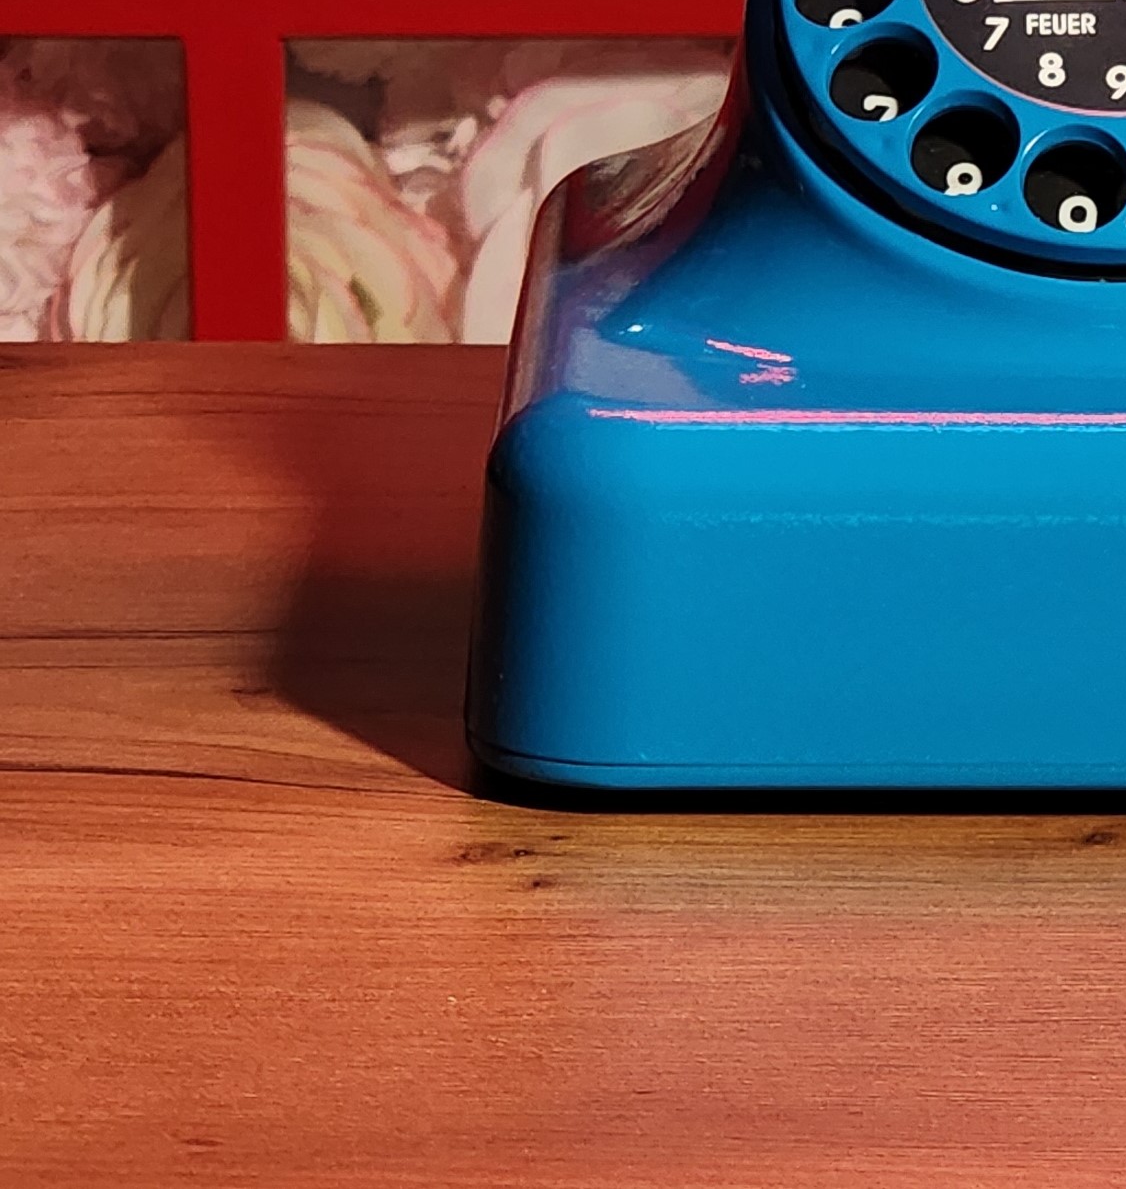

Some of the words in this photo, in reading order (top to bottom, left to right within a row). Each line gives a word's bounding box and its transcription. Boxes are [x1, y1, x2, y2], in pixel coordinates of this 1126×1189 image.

[983, 16, 1010, 51] 7
[1025, 12, 1097, 36] FEUER
[1037, 51, 1066, 88] 8
